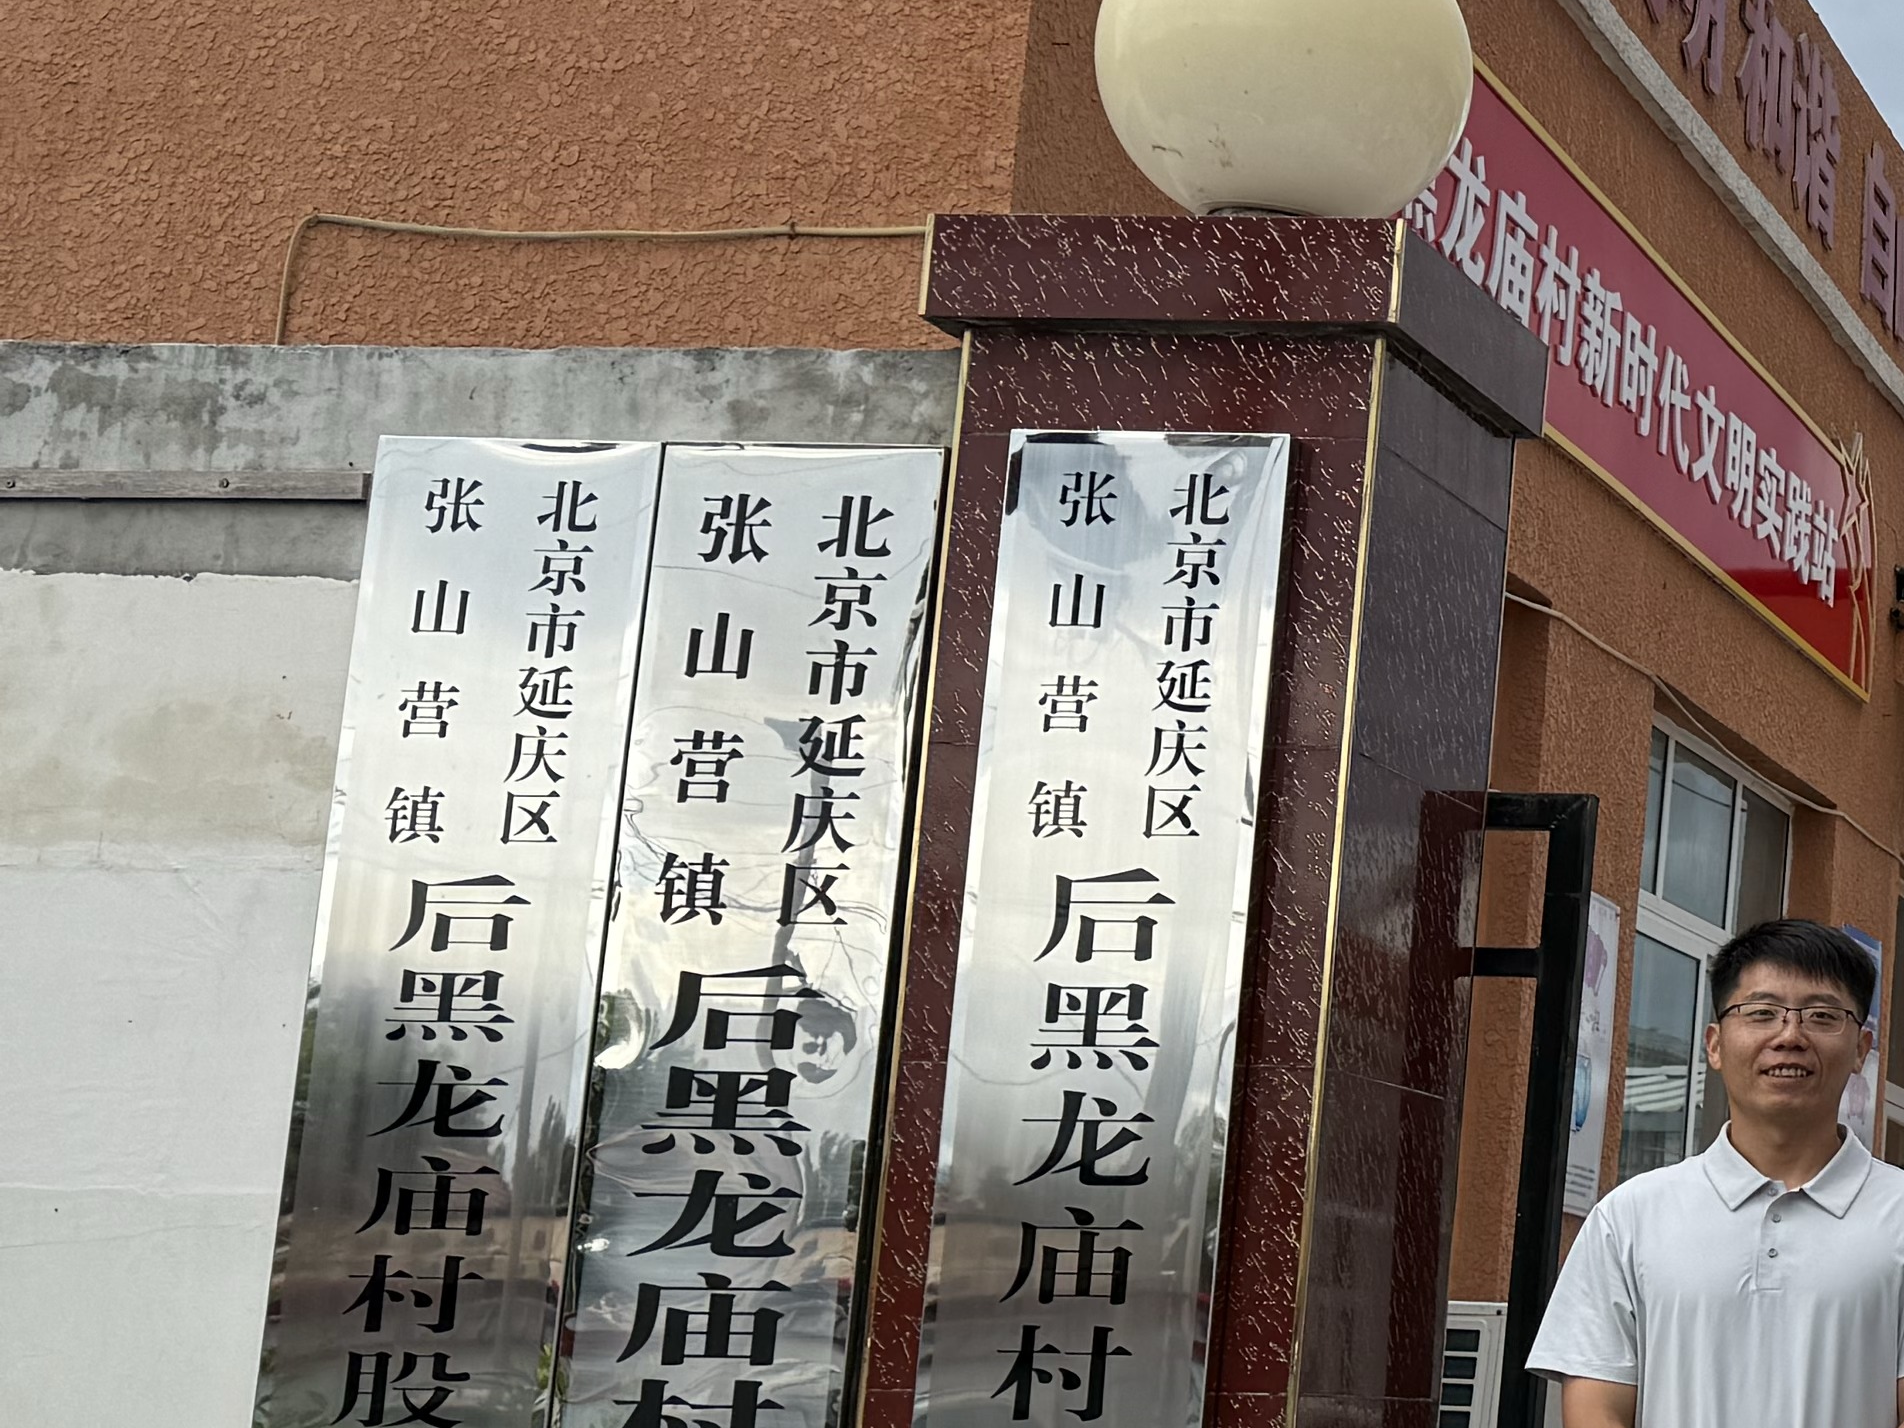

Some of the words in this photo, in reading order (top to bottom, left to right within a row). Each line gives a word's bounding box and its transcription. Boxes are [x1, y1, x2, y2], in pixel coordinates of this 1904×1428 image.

[385, 477, 485, 844] 张山营镇
[500, 481, 598, 844] 北京市延庆区
[655, 493, 773, 925] 张山营镇
[777, 495, 895, 927] 北京市延庆区
[1028, 471, 1118, 838] 张山营镇
[1142, 473, 1231, 839] 北京市延庆区
